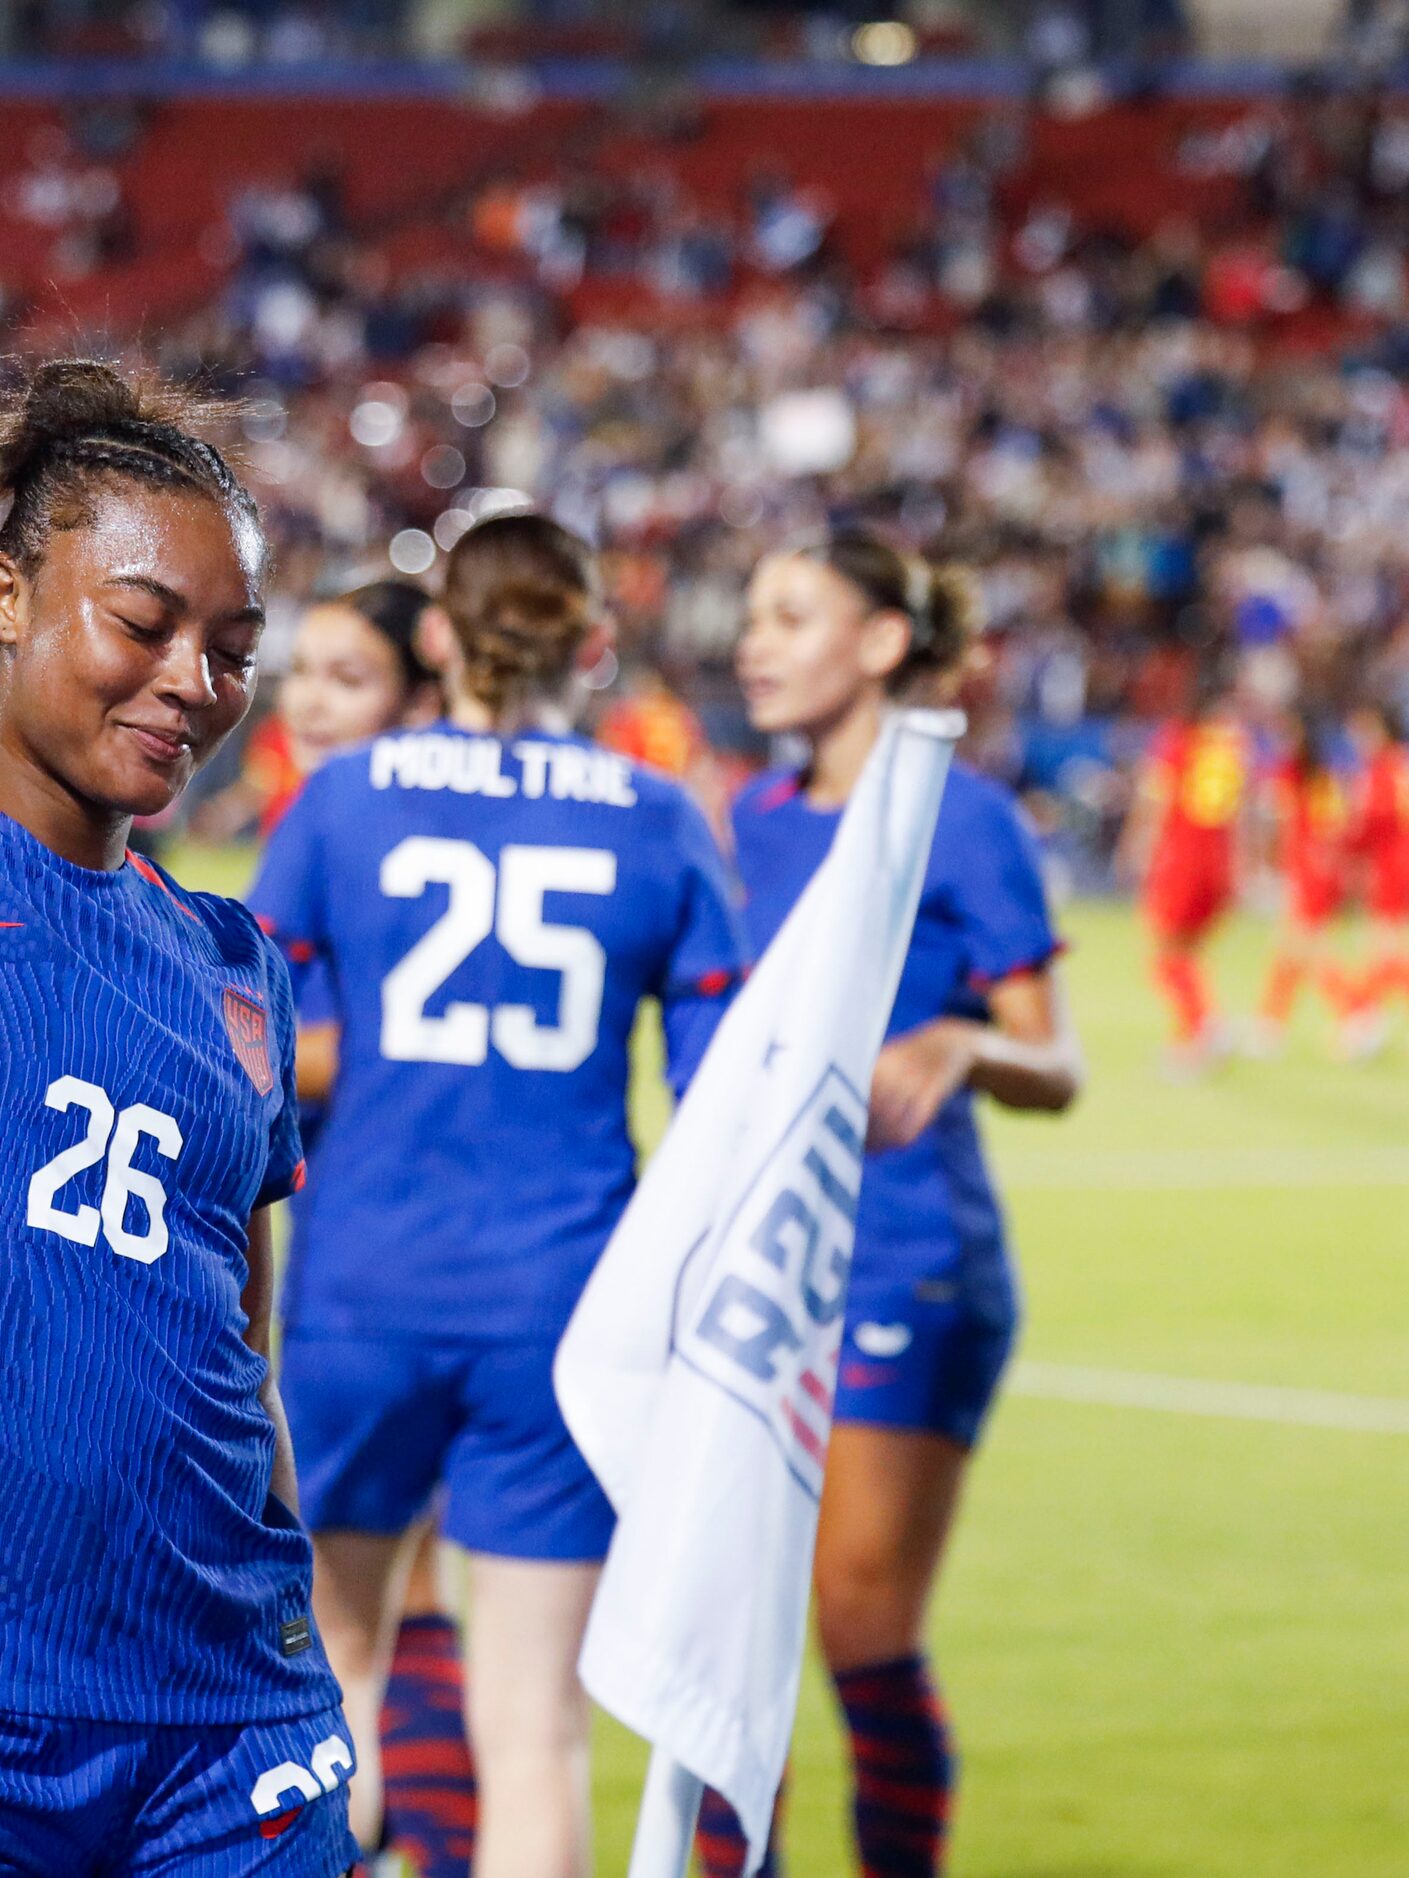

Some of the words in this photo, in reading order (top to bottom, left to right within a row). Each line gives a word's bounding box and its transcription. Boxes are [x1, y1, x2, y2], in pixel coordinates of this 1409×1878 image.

[370, 733, 637, 807] MOULTRIE
[378, 835, 617, 1072] 25
[226, 996, 264, 1043] USA
[27, 1075, 183, 1264] 26
